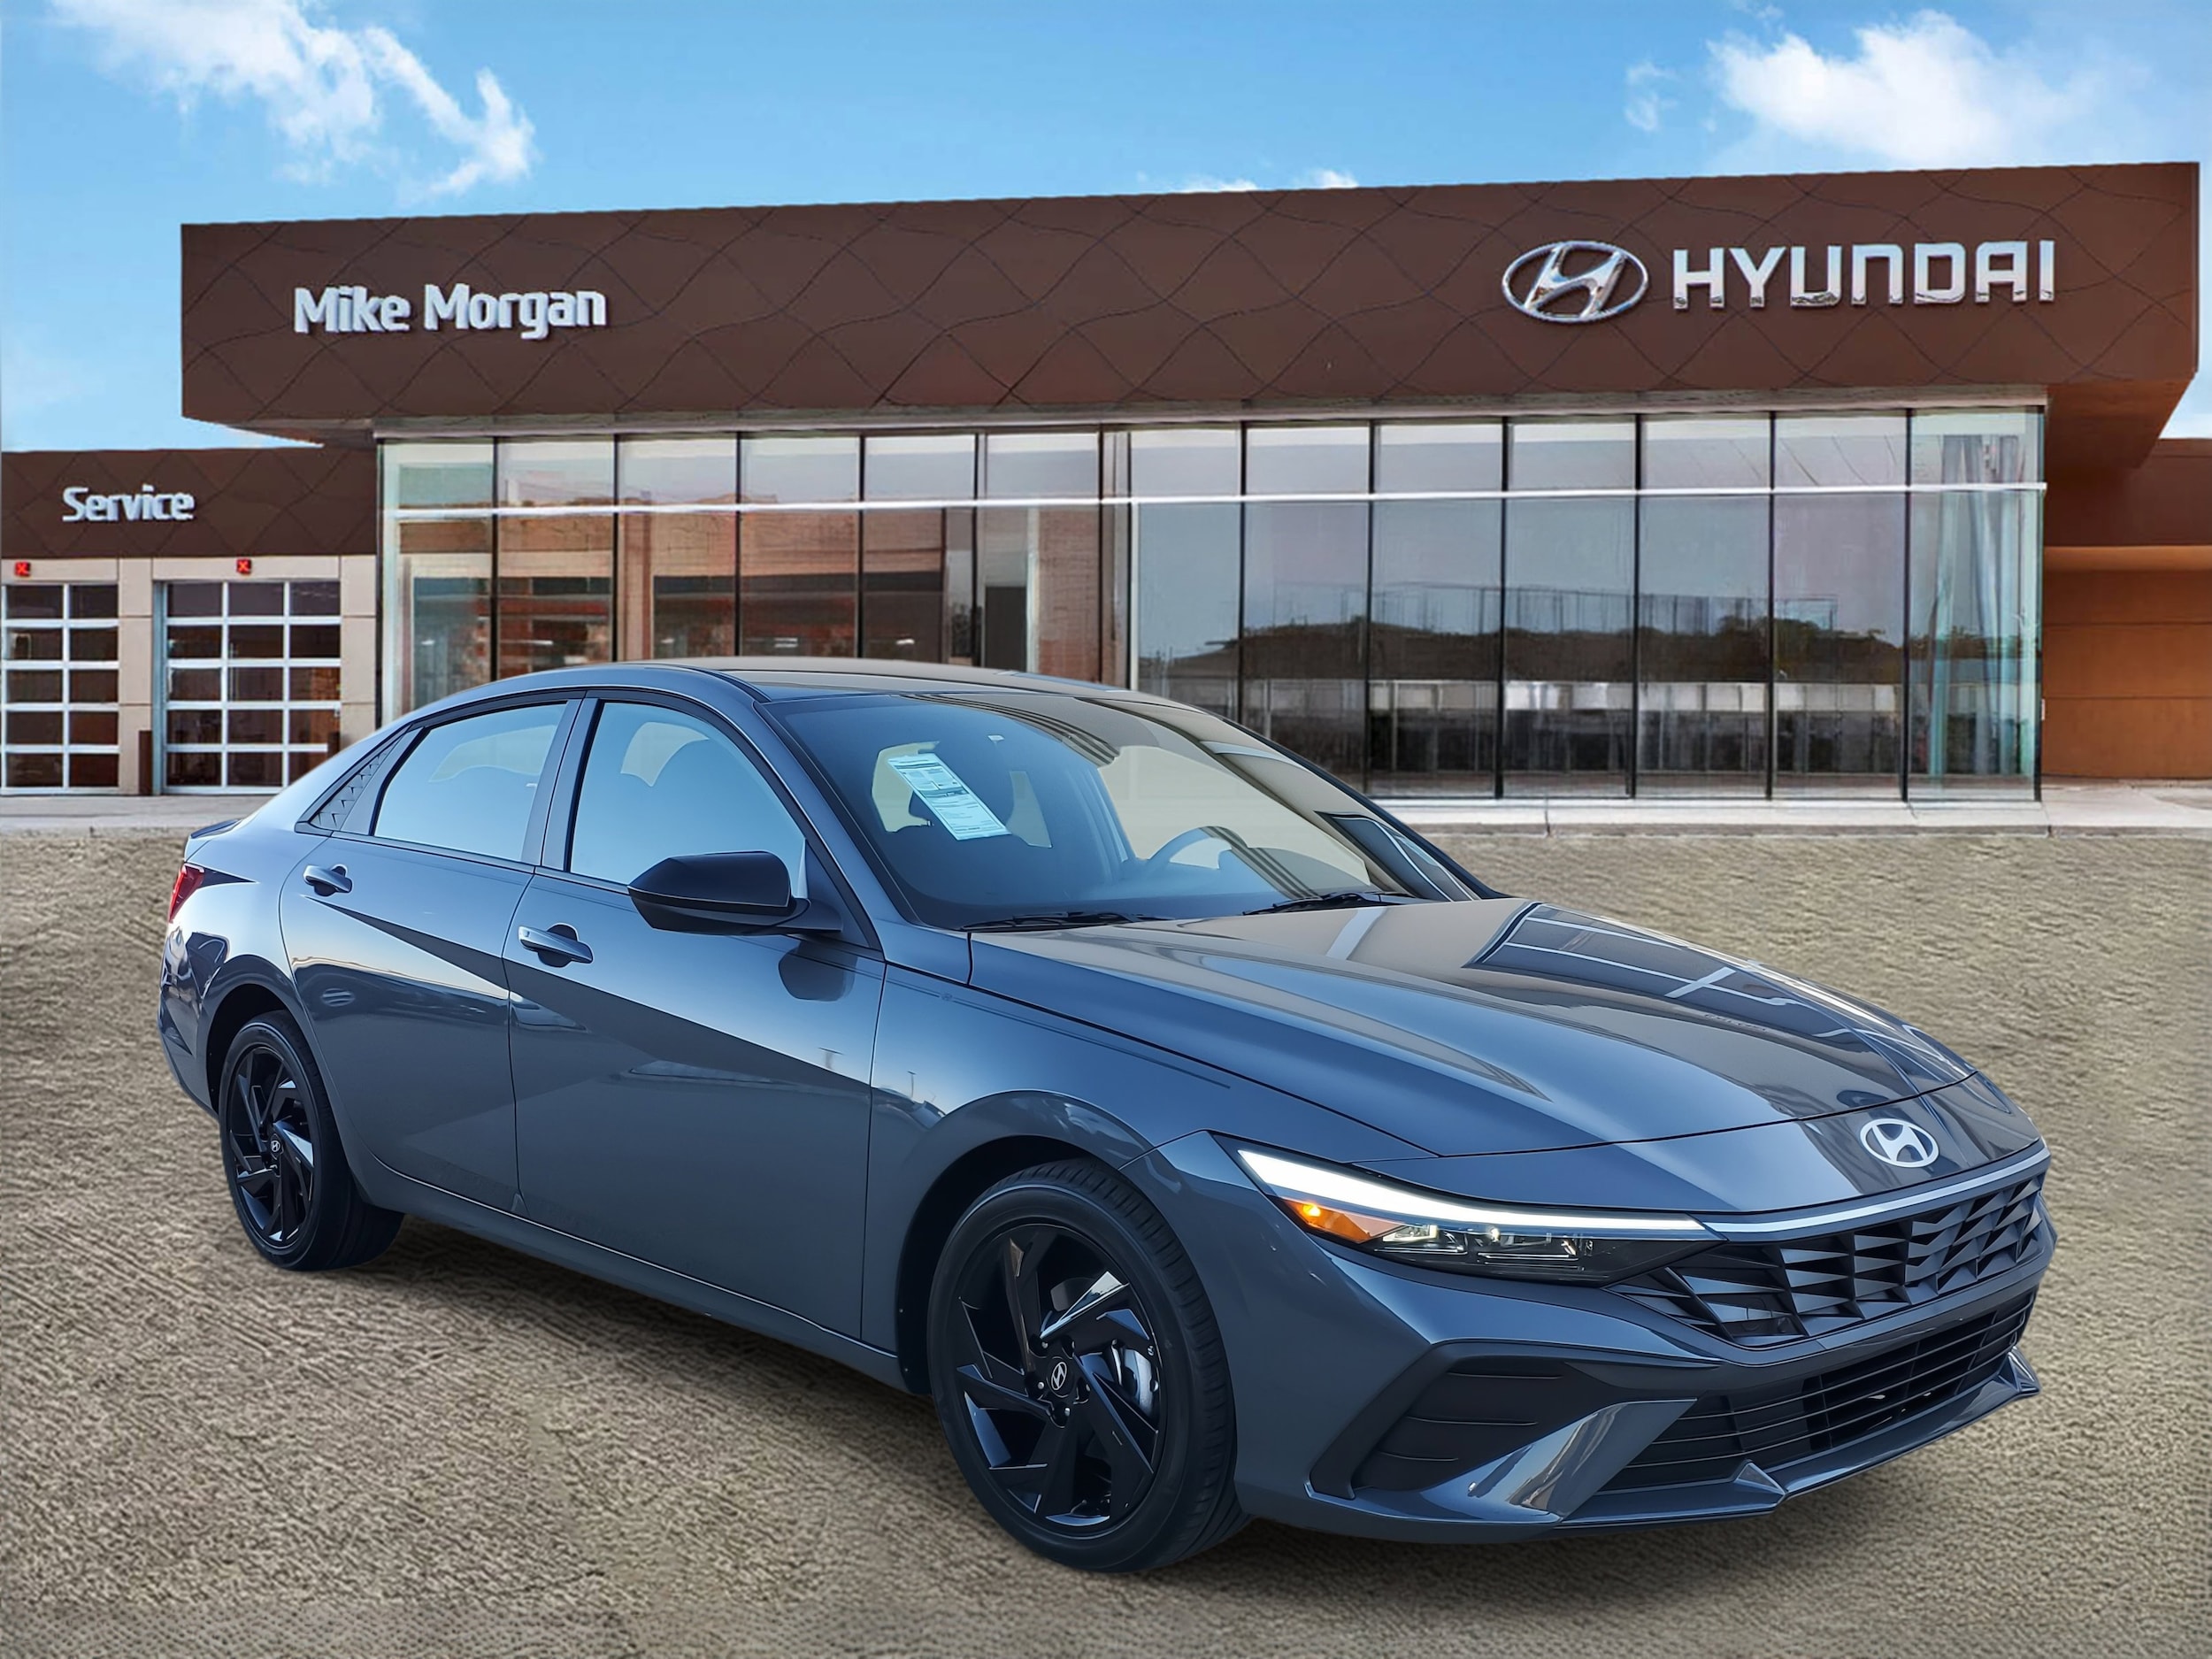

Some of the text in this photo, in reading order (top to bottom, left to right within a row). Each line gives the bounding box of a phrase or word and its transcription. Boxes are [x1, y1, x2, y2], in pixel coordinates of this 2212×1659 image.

[1673, 240, 2055, 309] HYUNDAI
[294, 283, 607, 340] Mike Morgan
[62, 484, 196, 522] Service
